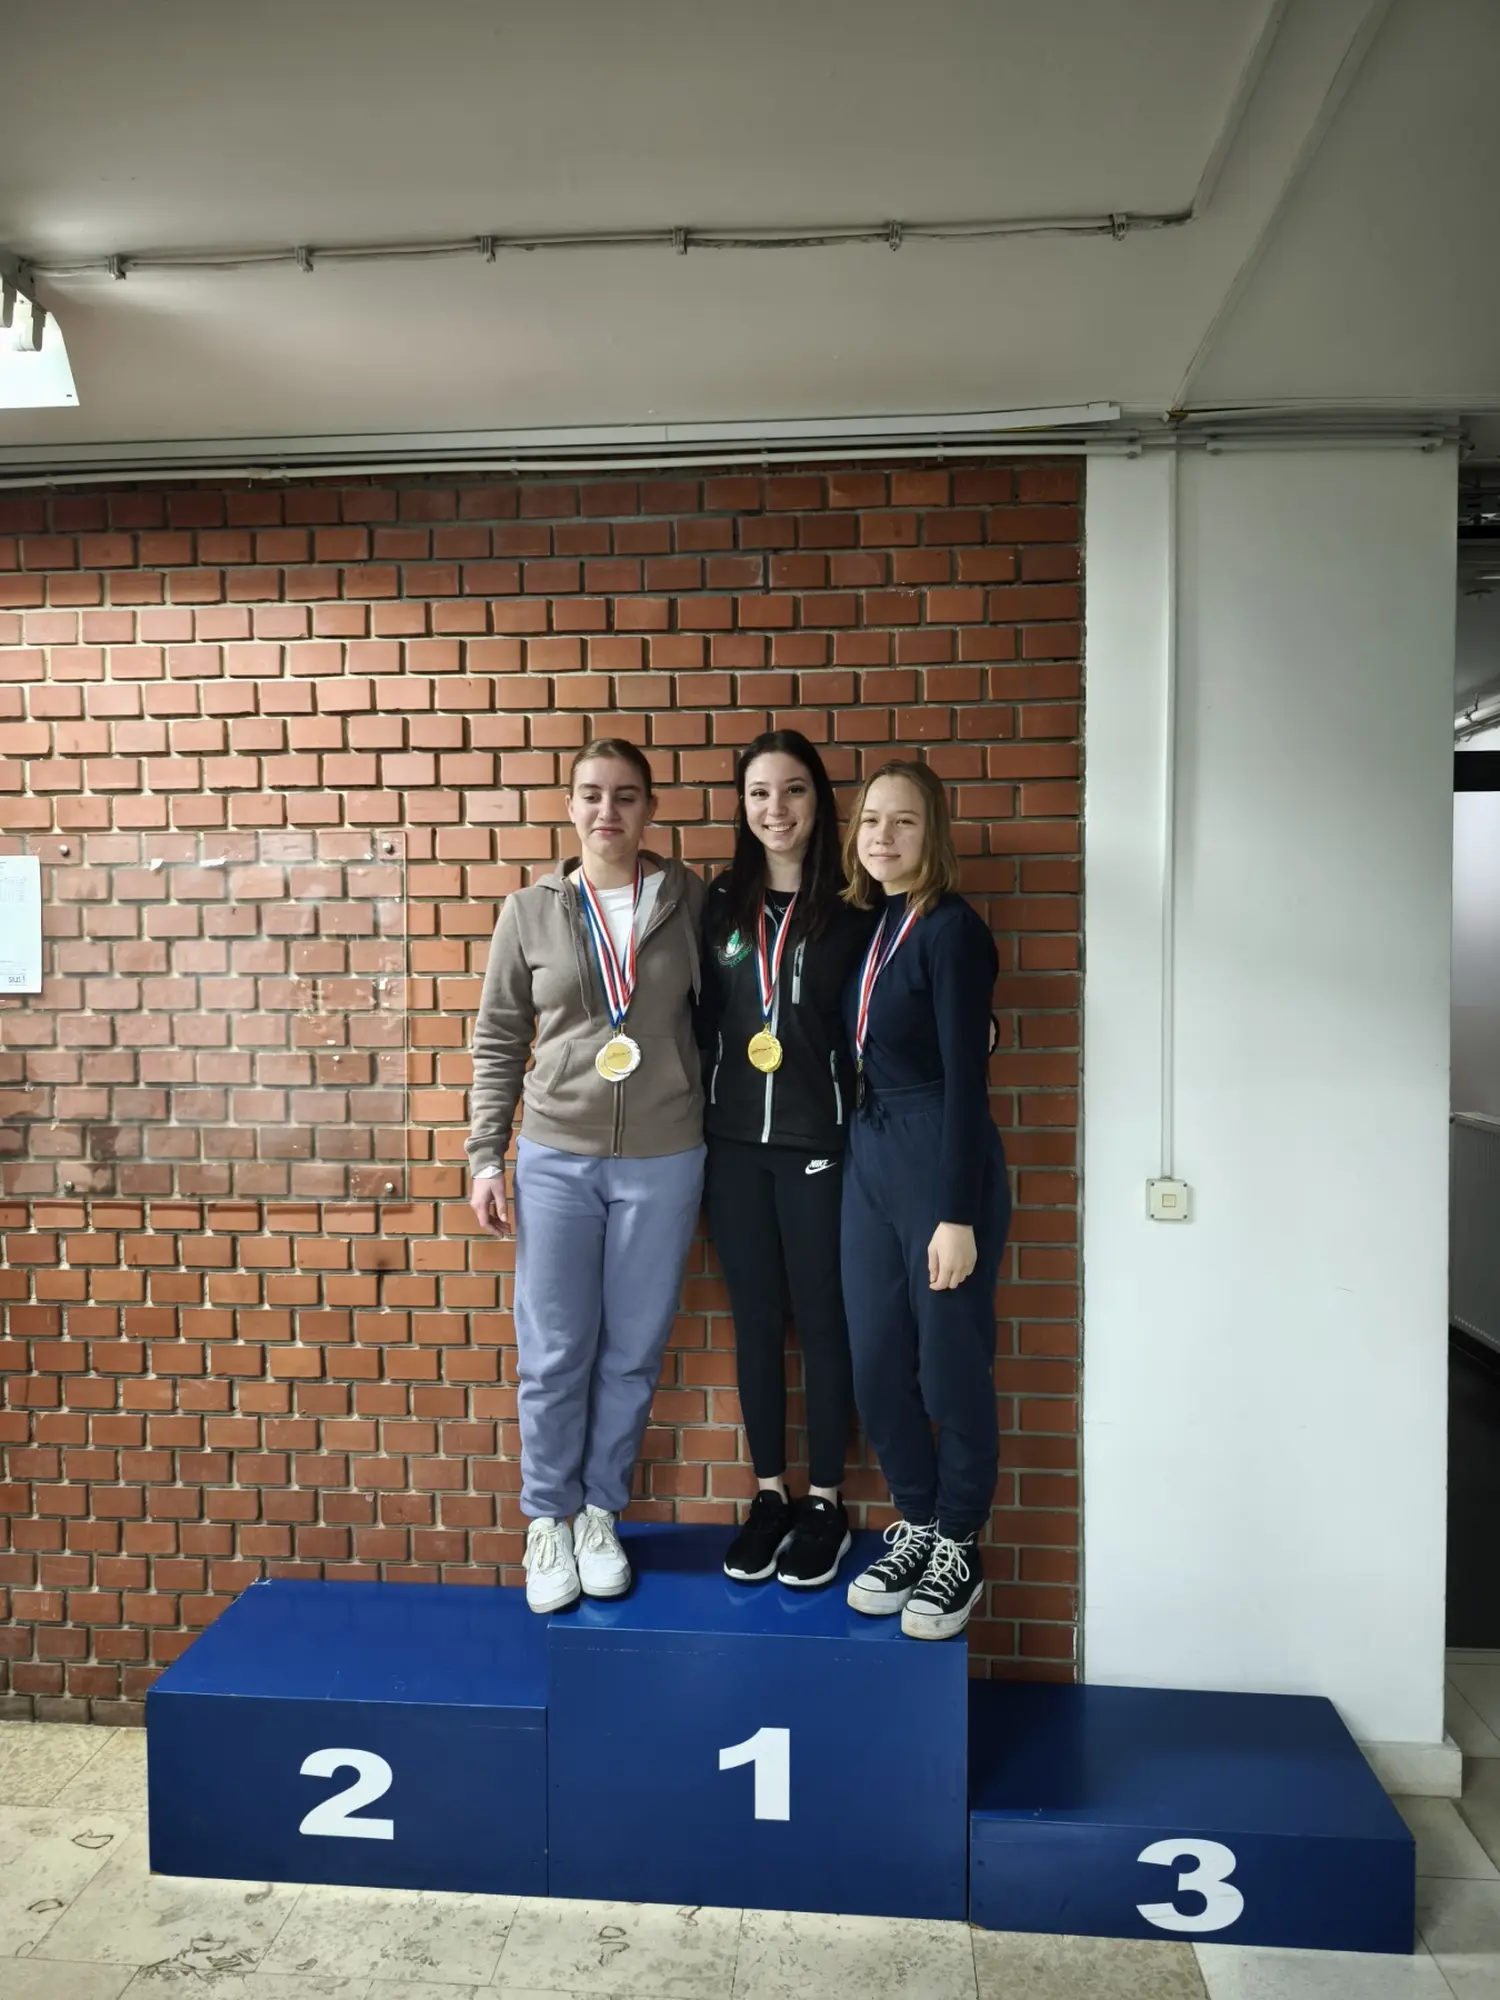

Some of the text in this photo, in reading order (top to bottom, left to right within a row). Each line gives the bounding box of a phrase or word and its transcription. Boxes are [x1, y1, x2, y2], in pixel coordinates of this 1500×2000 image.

[809, 1159, 829, 1169] NIKE
[299, 1749, 393, 1839] 2
[719, 1728, 790, 1820] 1
[1136, 1838, 1244, 1932] 3
